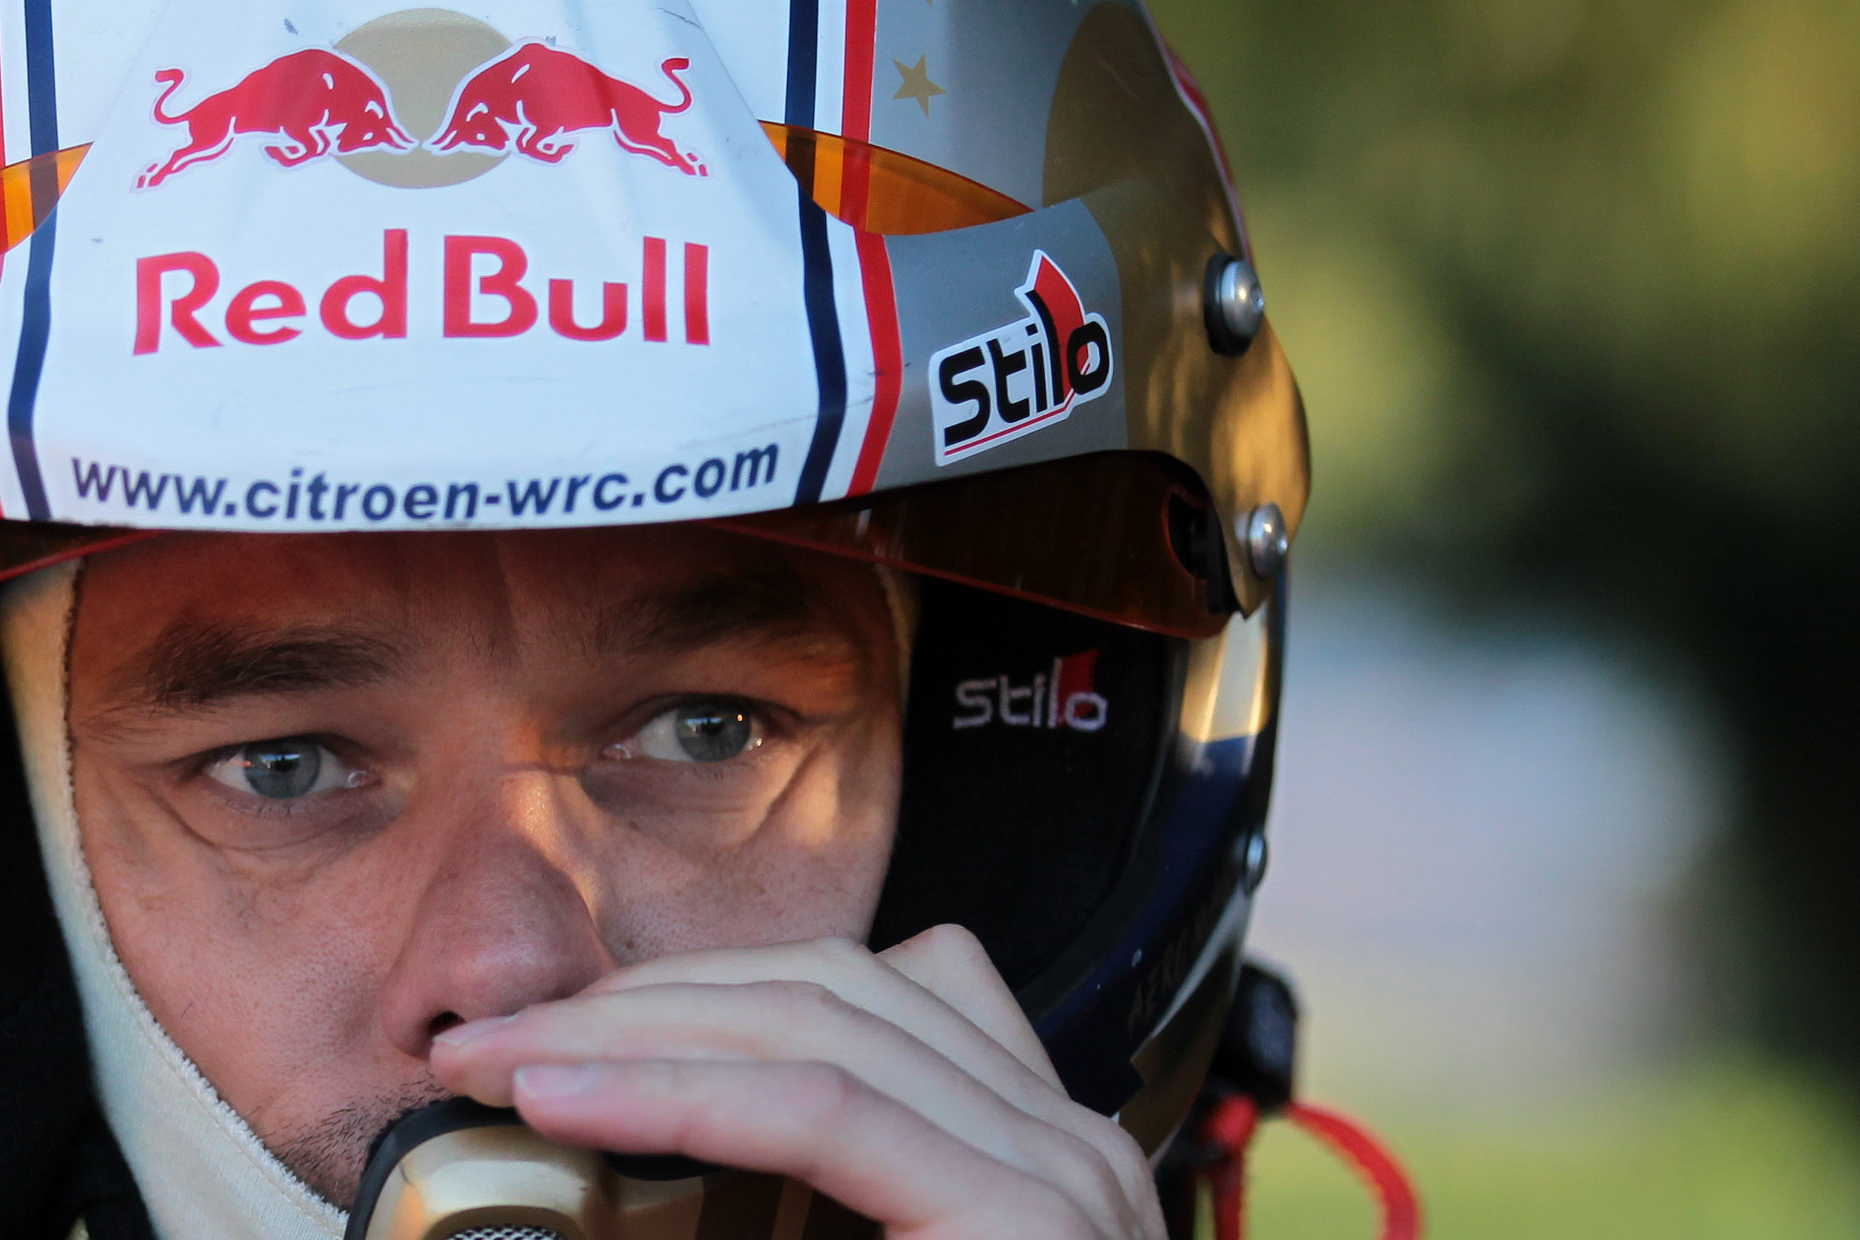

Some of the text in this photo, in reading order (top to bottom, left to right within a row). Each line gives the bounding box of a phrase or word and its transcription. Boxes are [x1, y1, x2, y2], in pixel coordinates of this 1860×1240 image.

[133, 229, 711, 357] Red Bull
[940, 285, 1112, 448] Stilo
[71, 442, 780, 522] www.citroen-wrc.com
